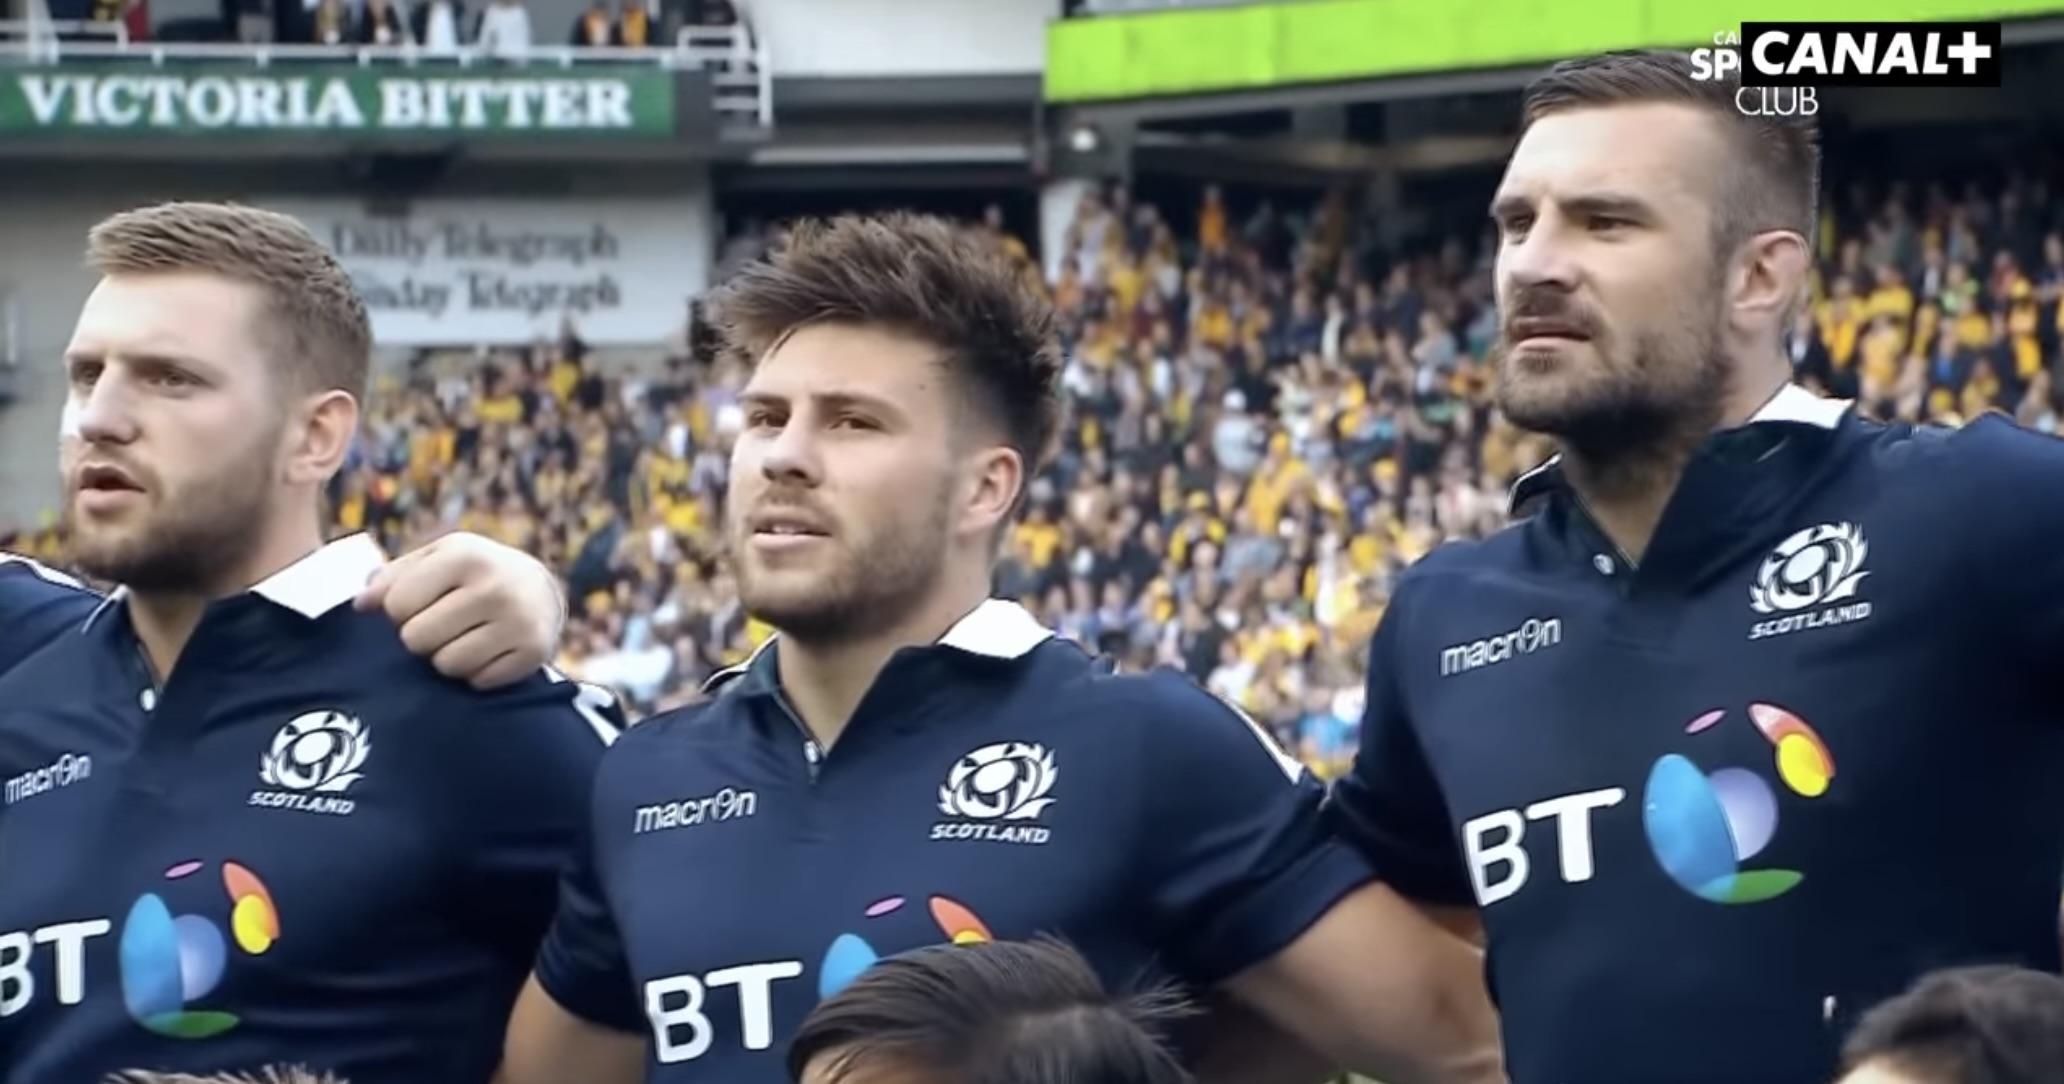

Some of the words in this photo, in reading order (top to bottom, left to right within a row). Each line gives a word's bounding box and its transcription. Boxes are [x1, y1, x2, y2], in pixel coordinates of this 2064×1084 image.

[19, 74, 364, 127] VICTORIA
[377, 78, 634, 128] BITTER
[1748, 601, 1872, 640] SCOTLAND
[248, 790, 356, 816] SCOTLAND
[929, 822, 1052, 845] SCOTLAND
[1461, 787, 1626, 906] BT
[644, 960, 803, 1064] BT
